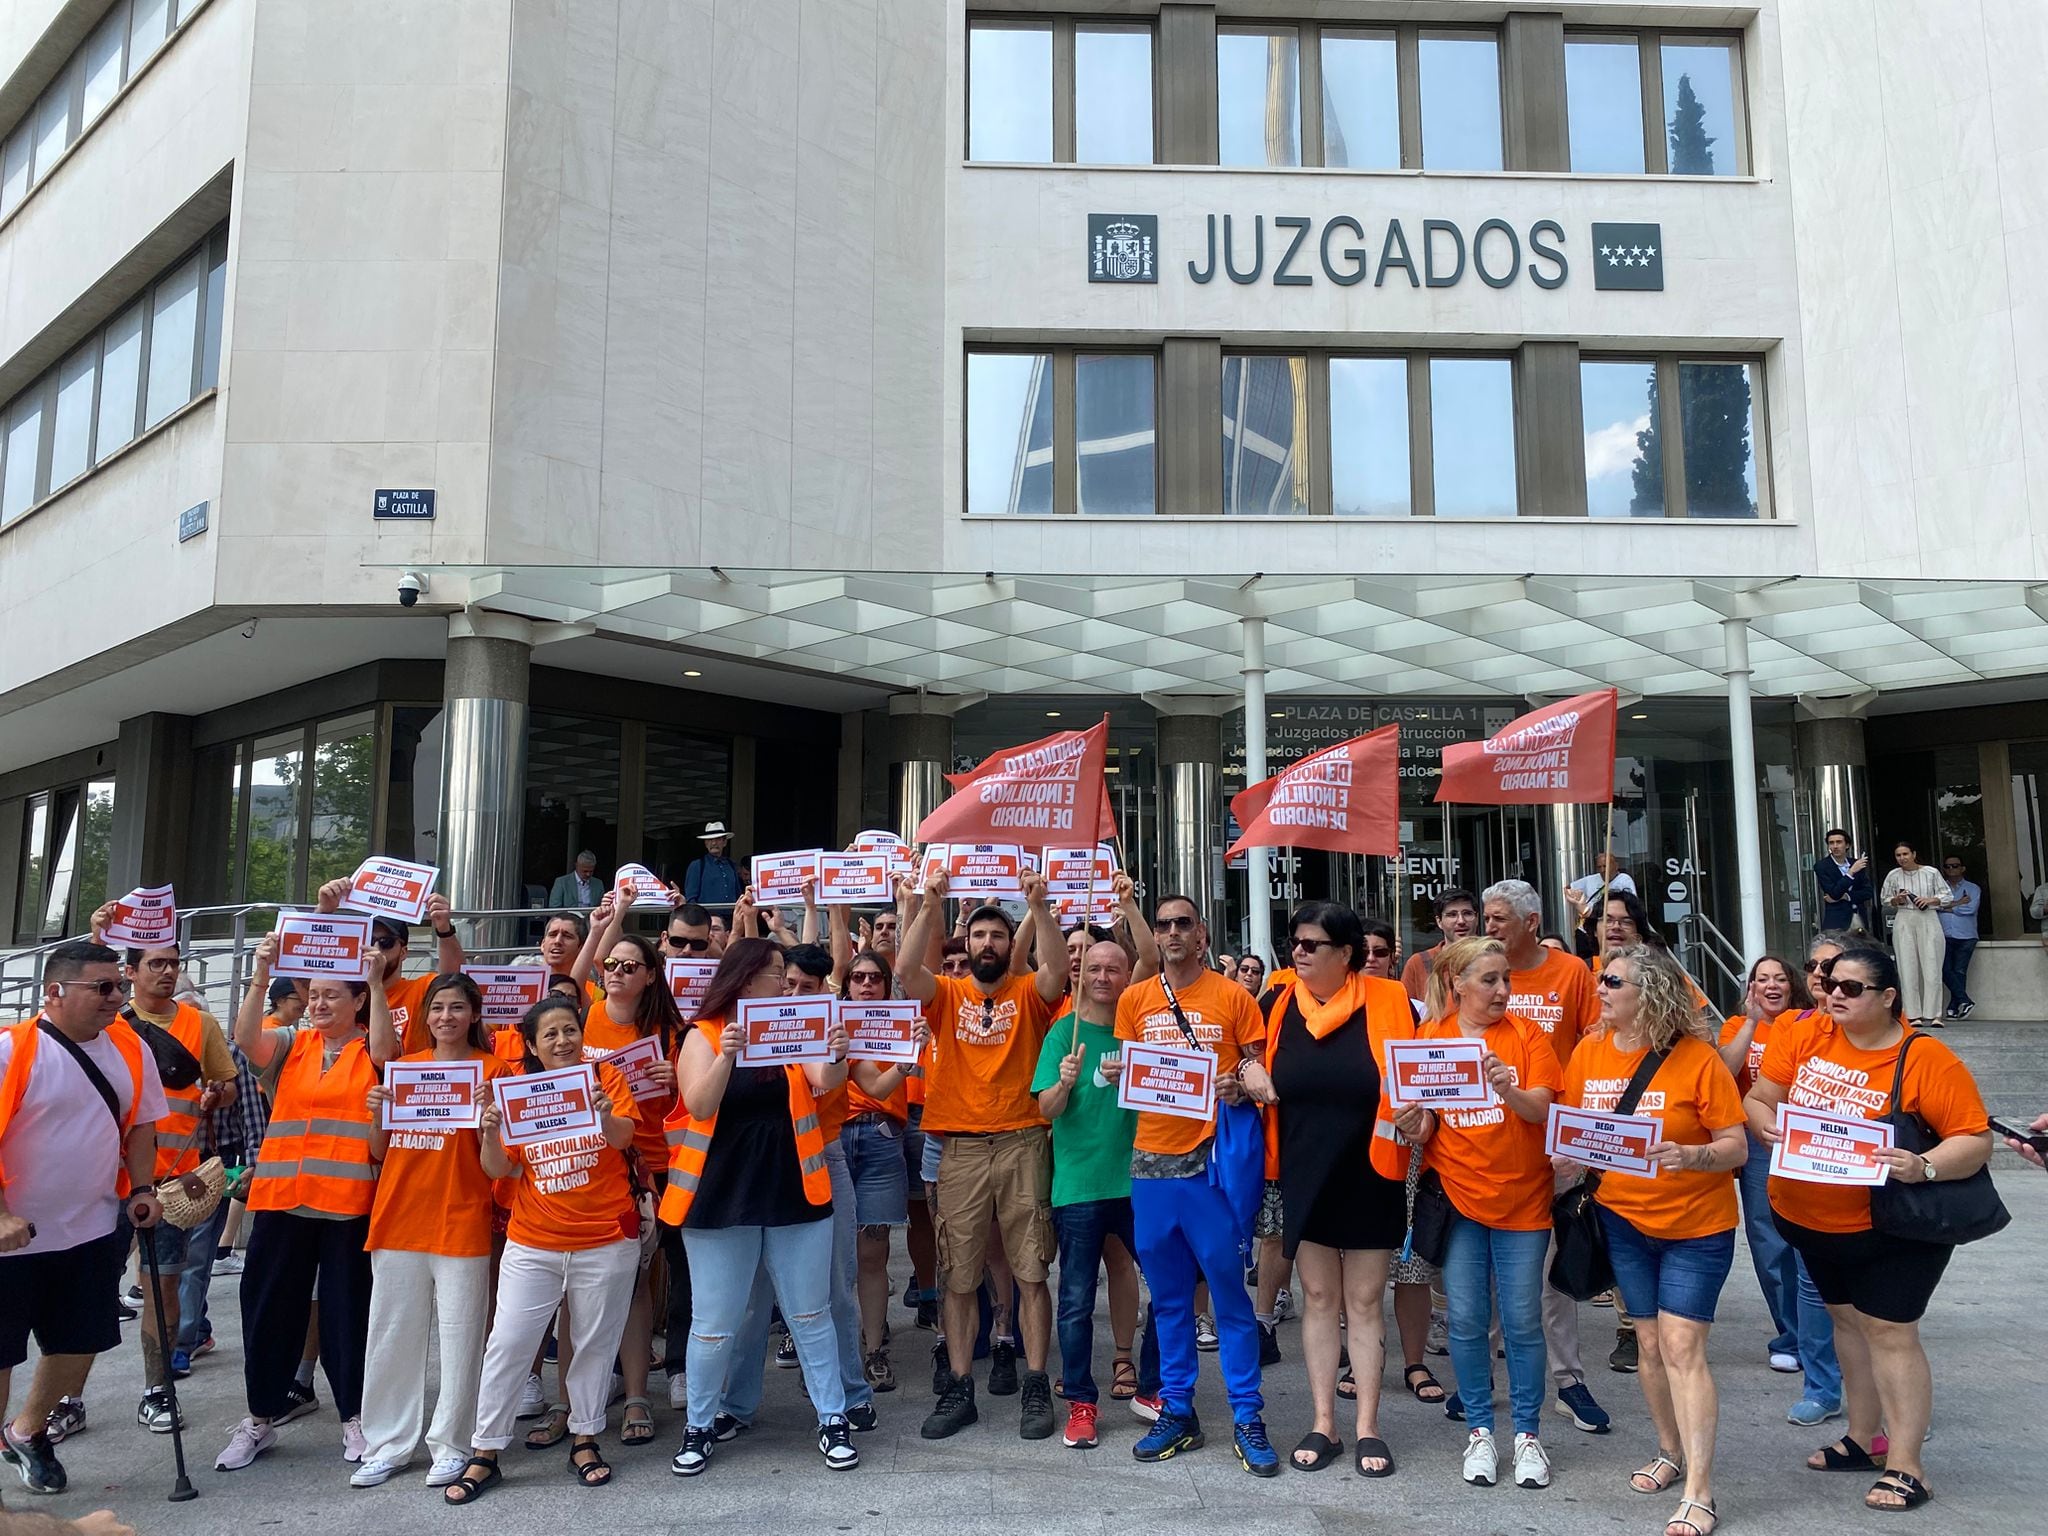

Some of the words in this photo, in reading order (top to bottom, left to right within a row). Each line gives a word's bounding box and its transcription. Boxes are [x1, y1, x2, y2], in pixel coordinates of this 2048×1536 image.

[1188, 214, 1569, 289] JUZGADOS
[392, 504, 428, 514] CASTILLA
[1286, 707, 1342, 720] PLAZA
[1348, 707, 1371, 720] DE
[1380, 708, 1464, 720] CASTILLA
[1470, 708, 1476, 720] 1
[1275, 726, 1349, 741] Juzgados
[1070, 850, 1087, 858] MARÍA
[967, 856, 976, 864] EN
[976, 856, 1000, 864] HUELGA
[377, 865, 392, 875] JUAN
[392, 867, 413, 878] CARLOS
[960, 866, 984, 874] CONTRA
[985, 866, 1009, 874] NESTAR
[970, 879, 998, 887] VALLECAS
[368, 895, 397, 908] MÓSTOLES
[312, 924, 333, 933] ISABEL
[132, 930, 160, 939] VALLECAS
[292, 945, 320, 954] CONTRA
[304, 959, 335, 969] VALLECAS
[496, 986, 521, 994] HUELGA
[487, 1006, 518, 1014] VICÁLVARO
[780, 1008, 797, 1017] SARA
[768, 1022, 778, 1031] EN
[778, 1020, 806, 1031] HUELGA
[759, 1031, 788, 1042] CONTRA
[788, 1030, 816, 1040] NESTAR
[854, 1030, 878, 1038] CONTRA
[956, 1028, 968, 1042] DE
[968, 1033, 1006, 1045] MADRID
[1146, 1031, 1159, 1041] DE
[772, 1044, 802, 1054] VALLECAS
[865, 1041, 891, 1050] VALLECAS
[1429, 1051, 1445, 1059] MATI
[1160, 1057, 1178, 1066] DAVID
[1418, 1064, 1429, 1073] EN
[1428, 1063, 1457, 1072] HUELGA
[1807, 1056, 1869, 1087] SINDICATO
[420, 1073, 446, 1081] MARCIA
[1150, 1068, 1160, 1077] EN
[1160, 1069, 1185, 1080] HUELGA
[1410, 1074, 1440, 1084] CONTRA
[1440, 1074, 1468, 1083] NESTAR
[415, 1084, 425, 1093] EN
[424, 1084, 452, 1093] HUELGA
[530, 1082, 556, 1093] HELENA
[1141, 1077, 1168, 1089] CONTRA
[1168, 1081, 1194, 1092] NESTAR
[1799, 1069, 1814, 1085] DE
[1810, 1074, 1884, 1107] INQUILINAS
[1421, 1088, 1460, 1097] VILLAVERDE
[406, 1094, 434, 1104] CONTRA
[434, 1093, 462, 1103] NESTAR
[526, 1097, 537, 1107] EN
[536, 1093, 564, 1106] HUELGA
[1156, 1094, 1175, 1103] PARLA
[1584, 1097, 1596, 1109] DE
[416, 1107, 451, 1117] MÓSTOLES
[520, 1106, 549, 1119] CONTRA
[548, 1102, 576, 1114] NESTAR
[1444, 1114, 1458, 1128] DE
[1458, 1108, 1504, 1128] MADRID
[535, 1118, 567, 1130] VALLECAS
[1595, 1122, 1615, 1131] BEGO
[1820, 1122, 1848, 1135] HELENA
[389, 1134, 402, 1148] DE
[402, 1134, 444, 1151] MADRID
[1582, 1130, 1593, 1139] EN
[1593, 1132, 1624, 1145] HUELGA
[1811, 1135, 1824, 1145] EN
[1823, 1136, 1855, 1151] HUELGA
[526, 1147, 542, 1162] DE
[542, 1134, 606, 1159] INQUILINAS
[1571, 1138, 1604, 1150] CONTRA
[1603, 1143, 1635, 1155] NESTAR
[1589, 1152, 1612, 1162] PARLA
[1800, 1144, 1833, 1158] CONTRA
[1833, 1150, 1866, 1164] NESTAR
[540, 1153, 599, 1177] INQUILINOS
[1812, 1162, 1848, 1175] VALLECAS
[547, 1170, 589, 1194] MADRID
